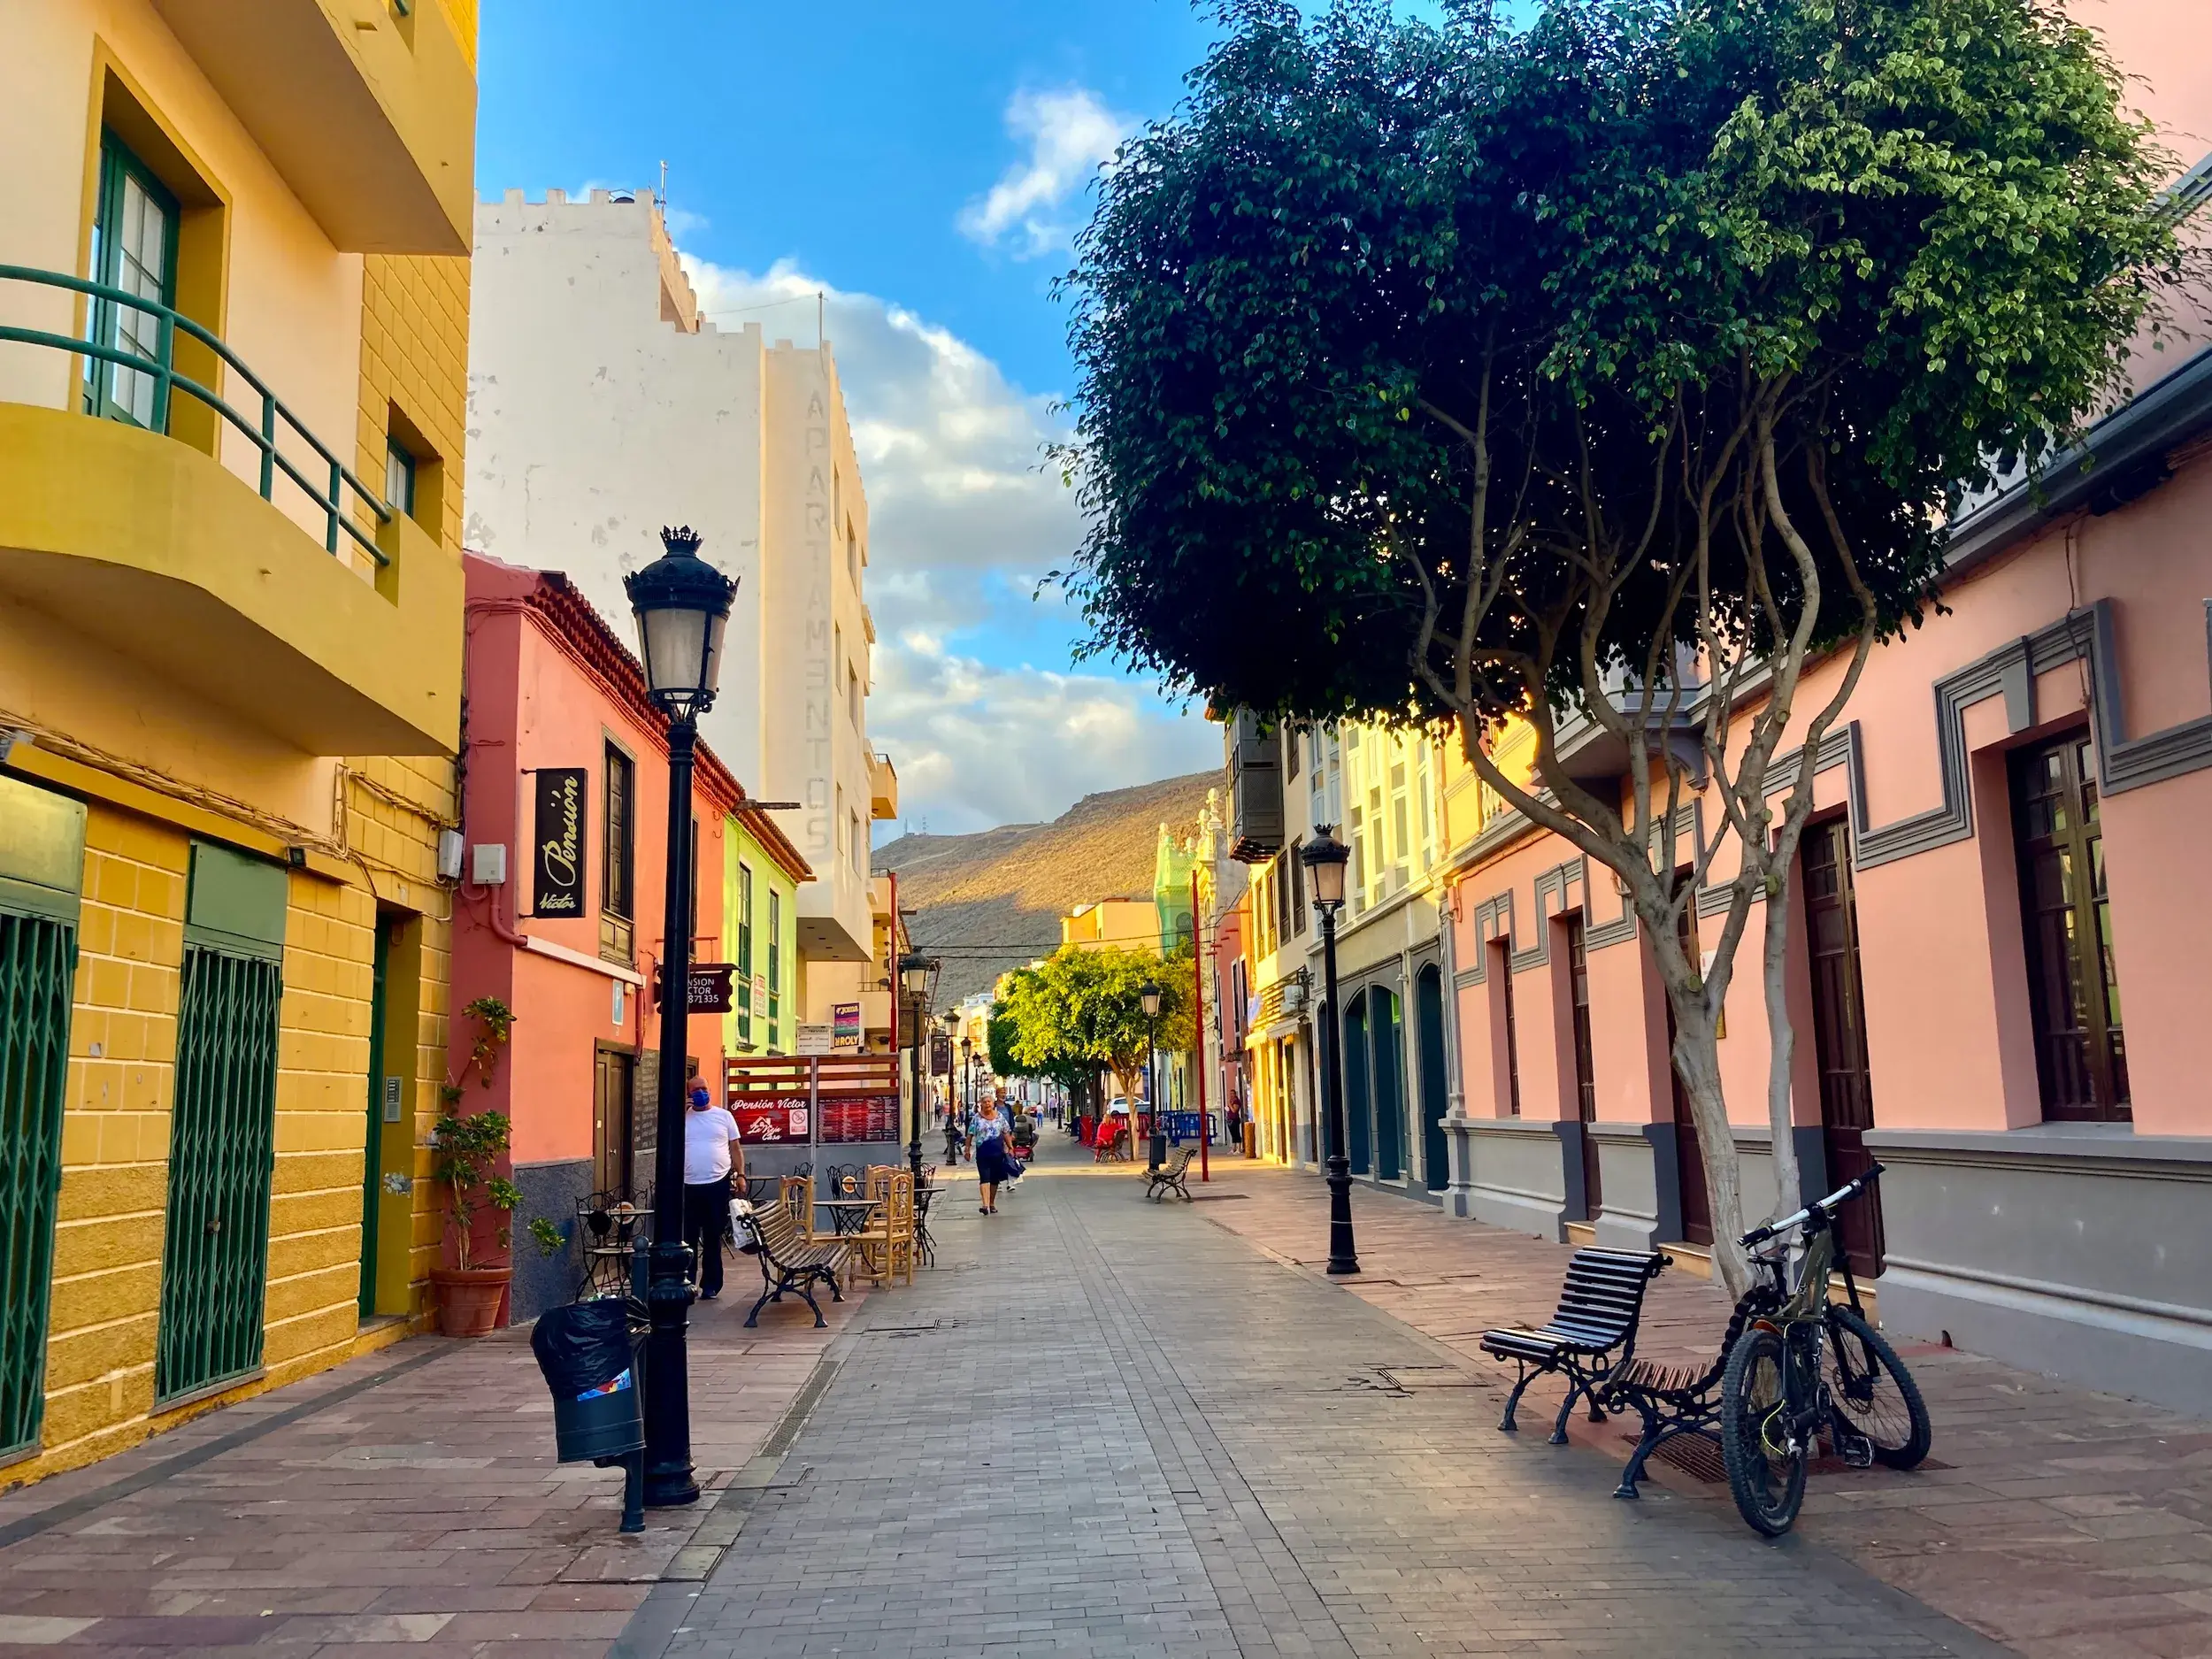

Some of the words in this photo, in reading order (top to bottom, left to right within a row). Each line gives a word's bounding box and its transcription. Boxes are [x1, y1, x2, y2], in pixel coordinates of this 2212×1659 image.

[541, 776, 579, 887] Pensión
[540, 892, 576, 910] Victor
[688, 978, 715, 987] NSION
[687, 987, 711, 995] CTOR
[731, 1099, 775, 1110] Pensión
[777, 1098, 807, 1109] Victor
